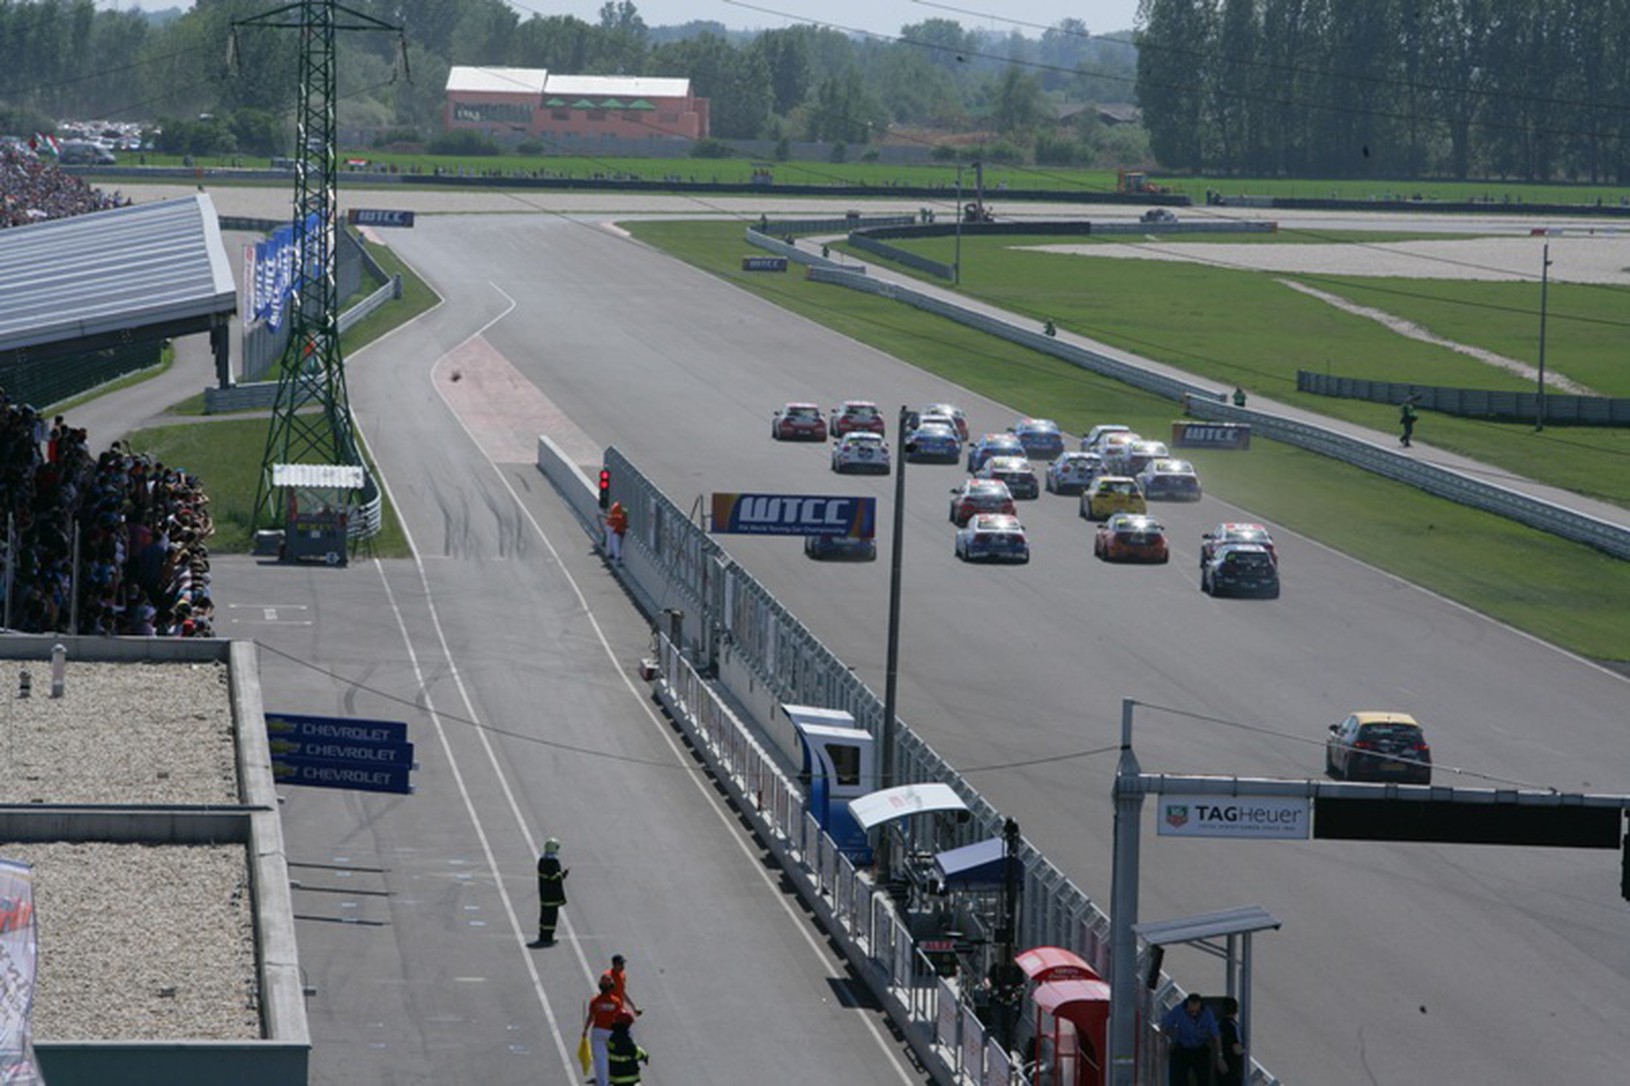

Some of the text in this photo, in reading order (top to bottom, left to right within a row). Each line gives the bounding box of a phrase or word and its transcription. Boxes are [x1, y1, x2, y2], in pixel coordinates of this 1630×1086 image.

[1185, 427, 1239, 441] WTCC
[739, 497, 850, 525] WTCC
[302, 722, 391, 741] CHEVROLET
[306, 743, 397, 761] CHEVROLET
[303, 766, 392, 785] CHEVROLET
